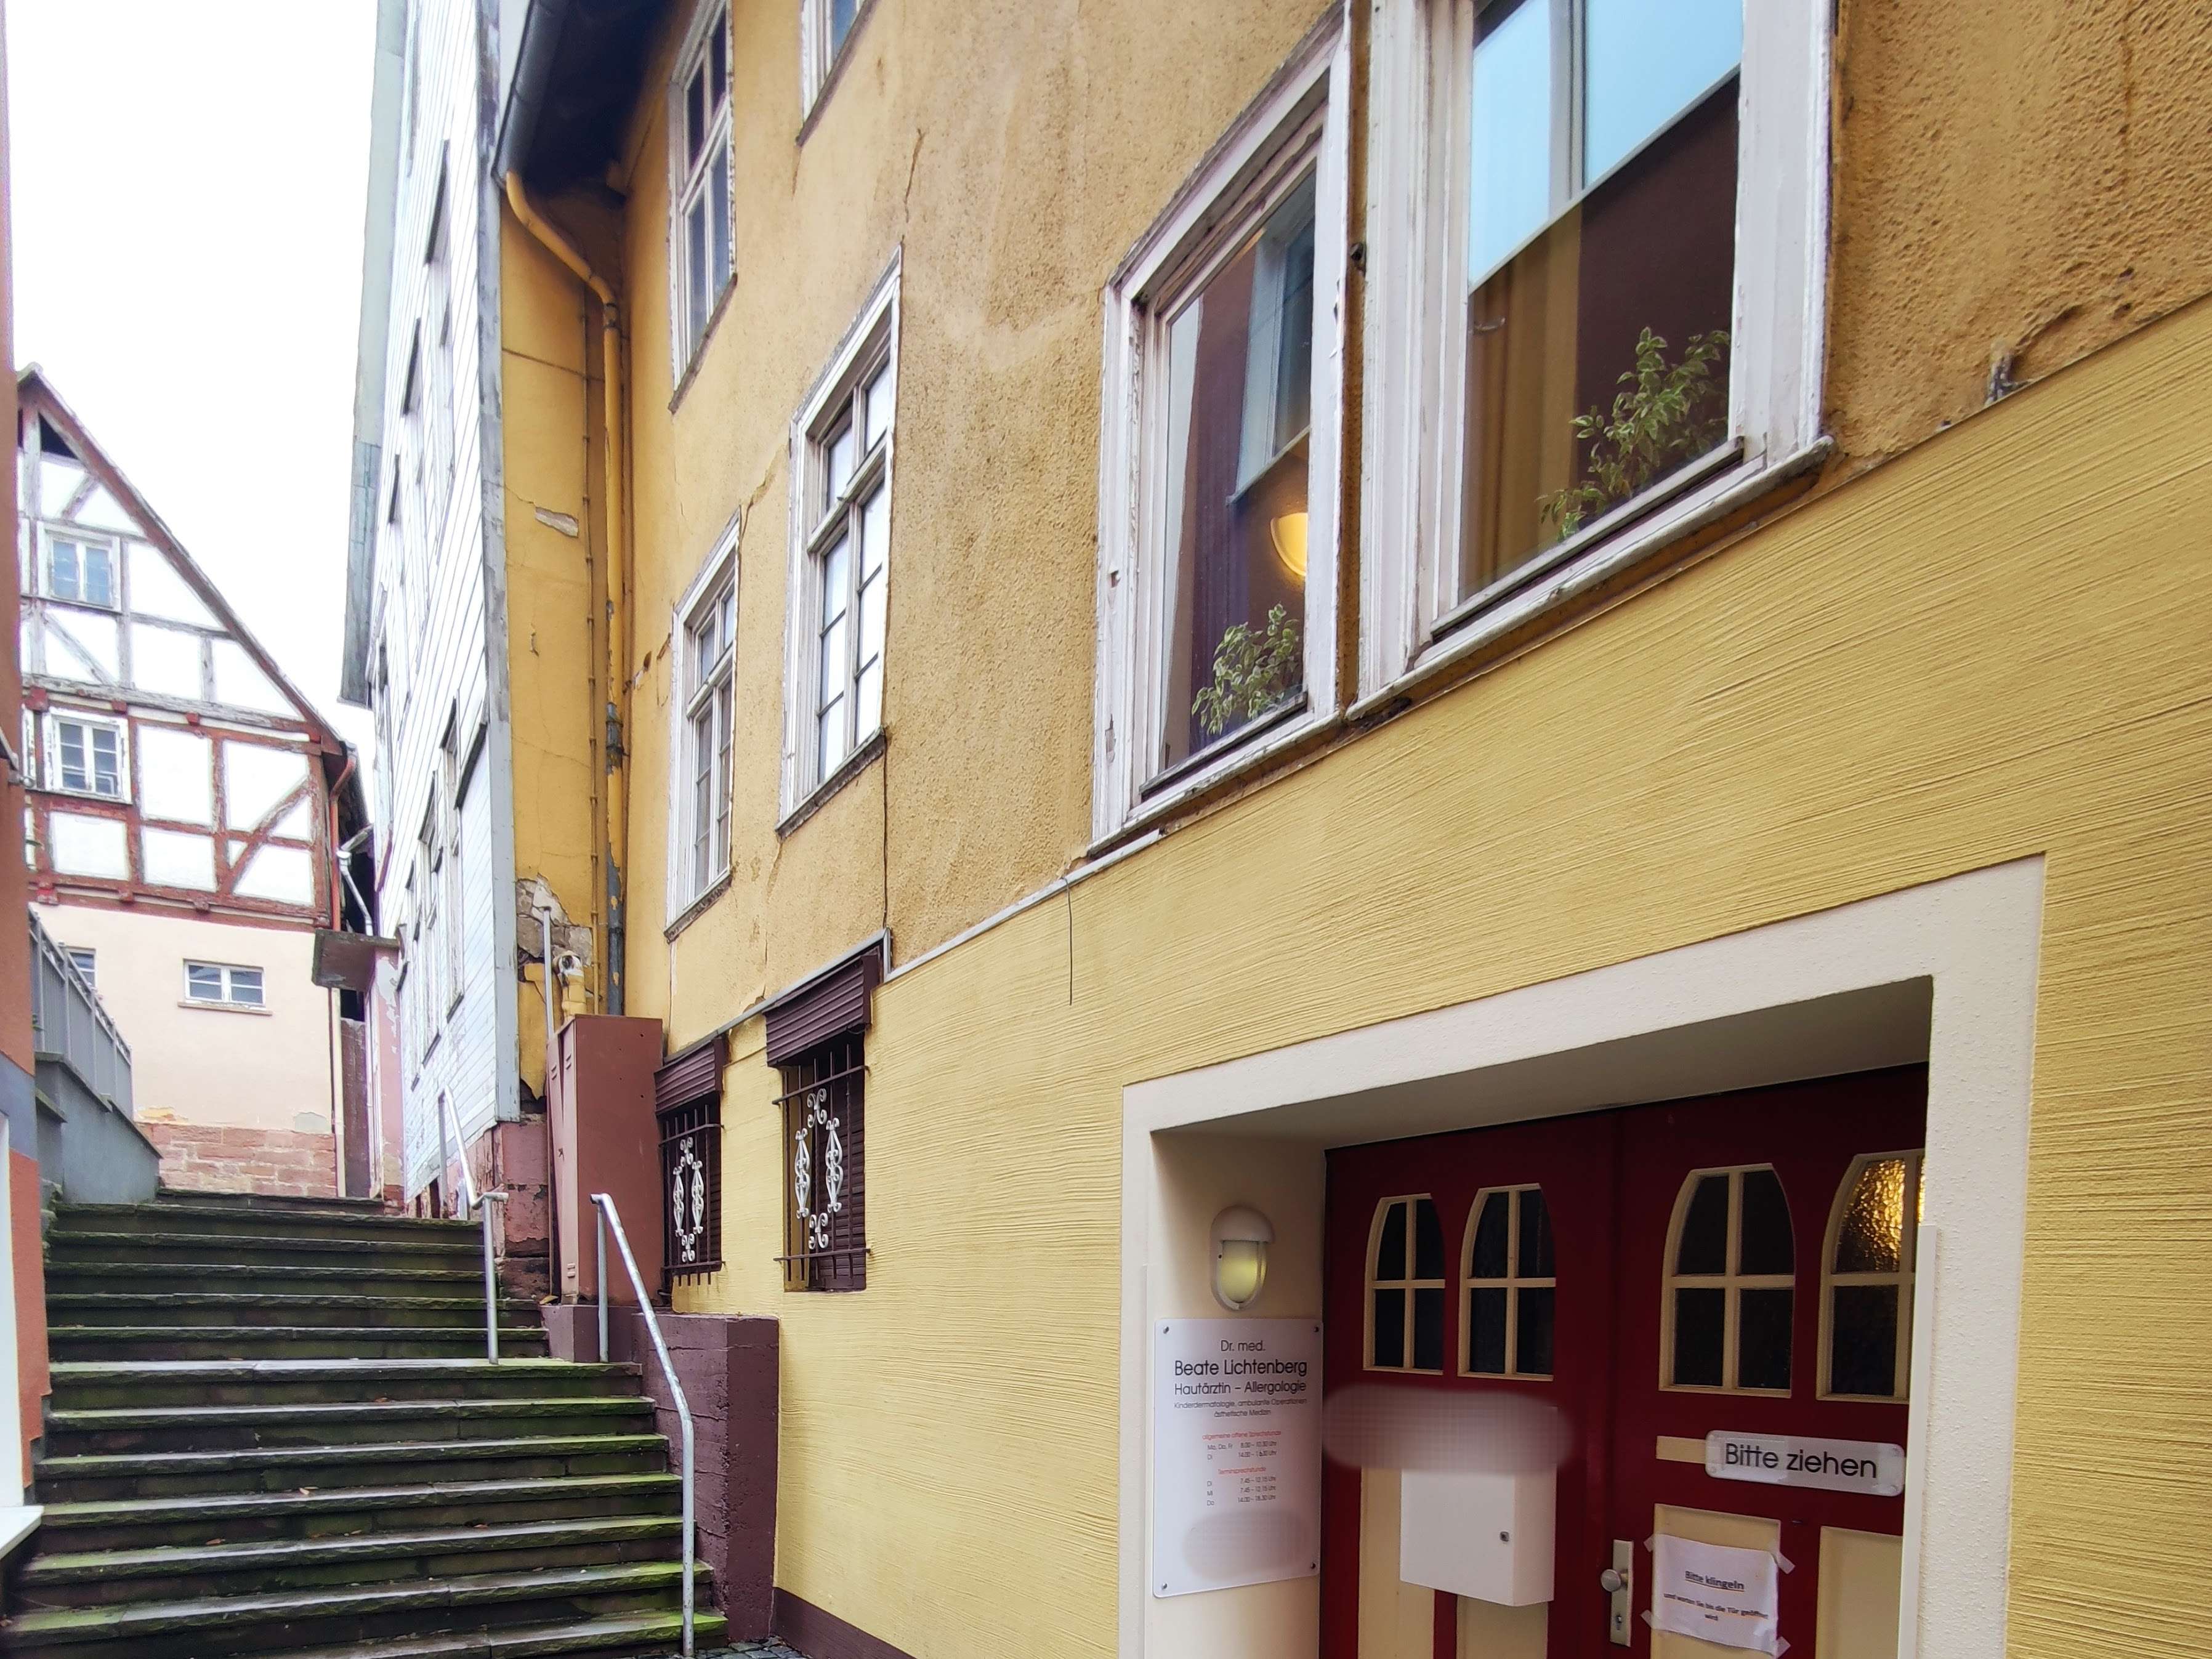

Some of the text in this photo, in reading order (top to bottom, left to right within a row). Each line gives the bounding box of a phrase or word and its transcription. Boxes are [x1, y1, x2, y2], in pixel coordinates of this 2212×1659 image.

[1221, 1339, 1266, 1352] Dr. med.
[1174, 1358, 1307, 1377] Beate Lichtenberg
[1174, 1382, 1231, 1395] Hautärztin
[1244, 1380, 1307, 1396] Allergologie
[1238, 1399, 1270, 1407] ambulante
[1272, 1398, 1307, 1406] Operationen
[1726, 1442, 1877, 1479] Bitte ziehen
[1685, 1570, 1745, 1590] Bitte klingeln
